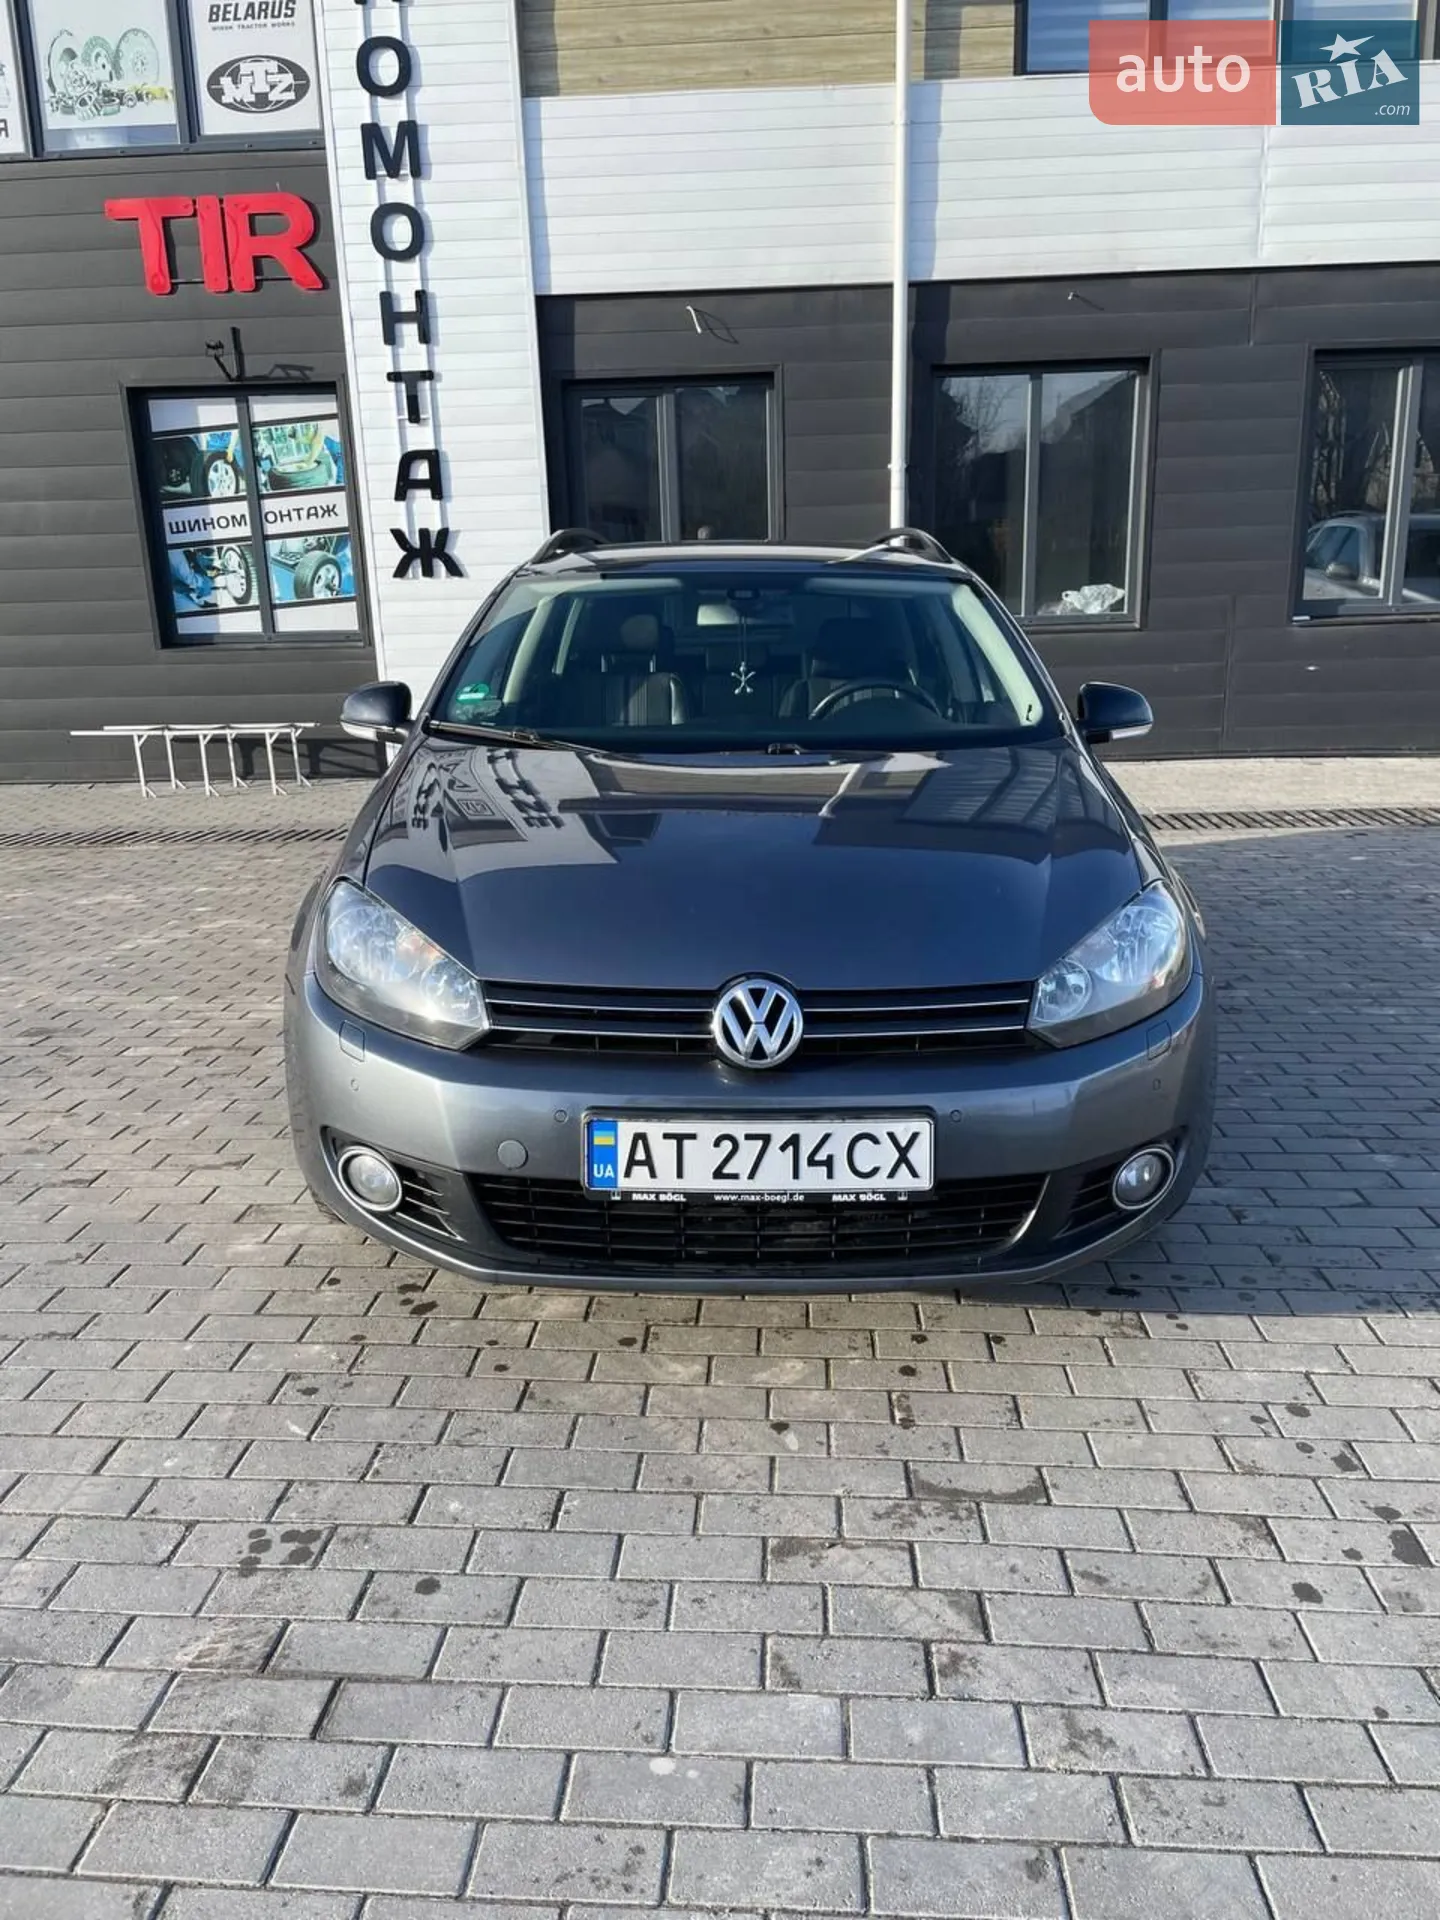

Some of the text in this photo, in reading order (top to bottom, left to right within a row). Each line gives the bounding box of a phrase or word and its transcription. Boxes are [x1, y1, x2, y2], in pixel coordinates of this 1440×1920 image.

[208, 0, 296, 22] BELARUS
[220, 62, 296, 103] MTZ
[104, 191, 324, 295] TIR
[354, 0, 465, 579] ОМОНТАЖ
[623, 1131, 921, 1180] AT 2714 CX
[593, 1163, 615, 1178] UA
[631, 1192, 656, 1201] MAX
[714, 1194, 805, 1203] www.max-boegl.de
[832, 1193, 856, 1202] MAX
